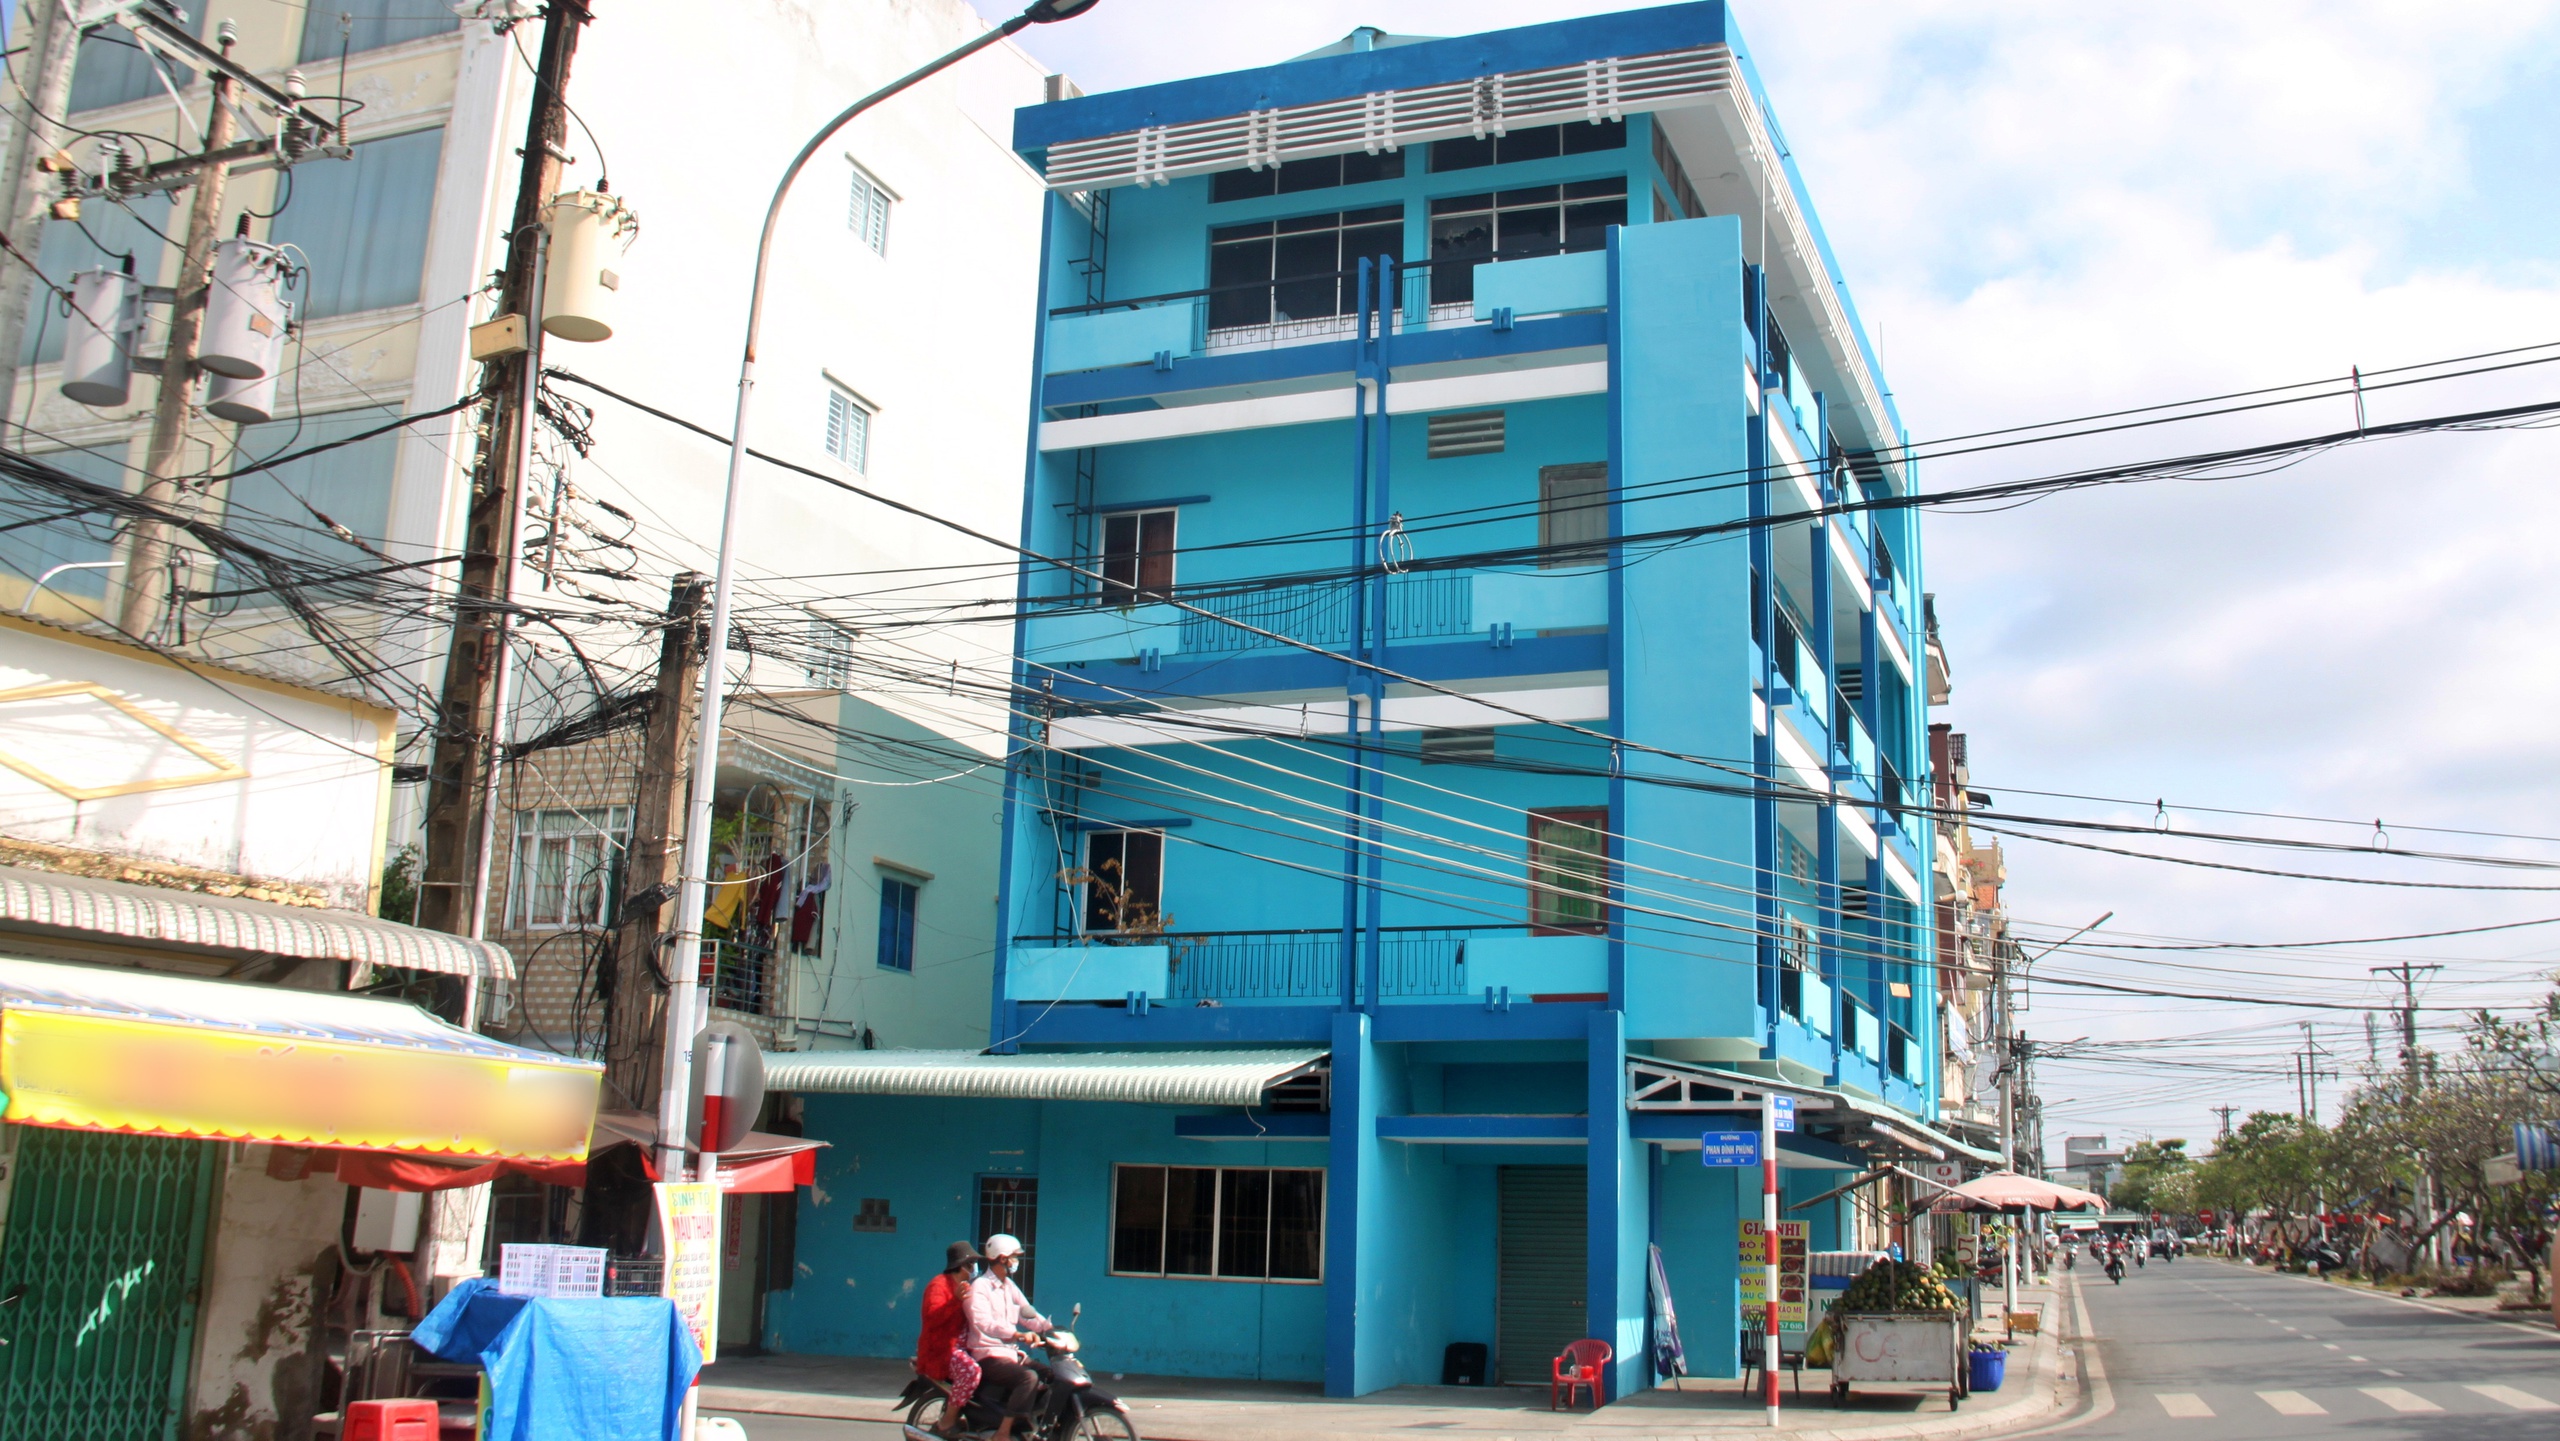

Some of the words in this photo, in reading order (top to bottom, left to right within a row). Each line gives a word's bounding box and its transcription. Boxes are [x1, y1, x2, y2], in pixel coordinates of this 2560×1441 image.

[1706, 1145, 1720, 1155] PHAN
[1721, 1143, 1735, 1155] ĐÌNH
[1735, 1143, 1754, 1154] PHÙNG
[672, 1192, 695, 1206] SINH
[1776, 1223, 1801, 1236] NHI
[1957, 1237, 1975, 1263] 5
